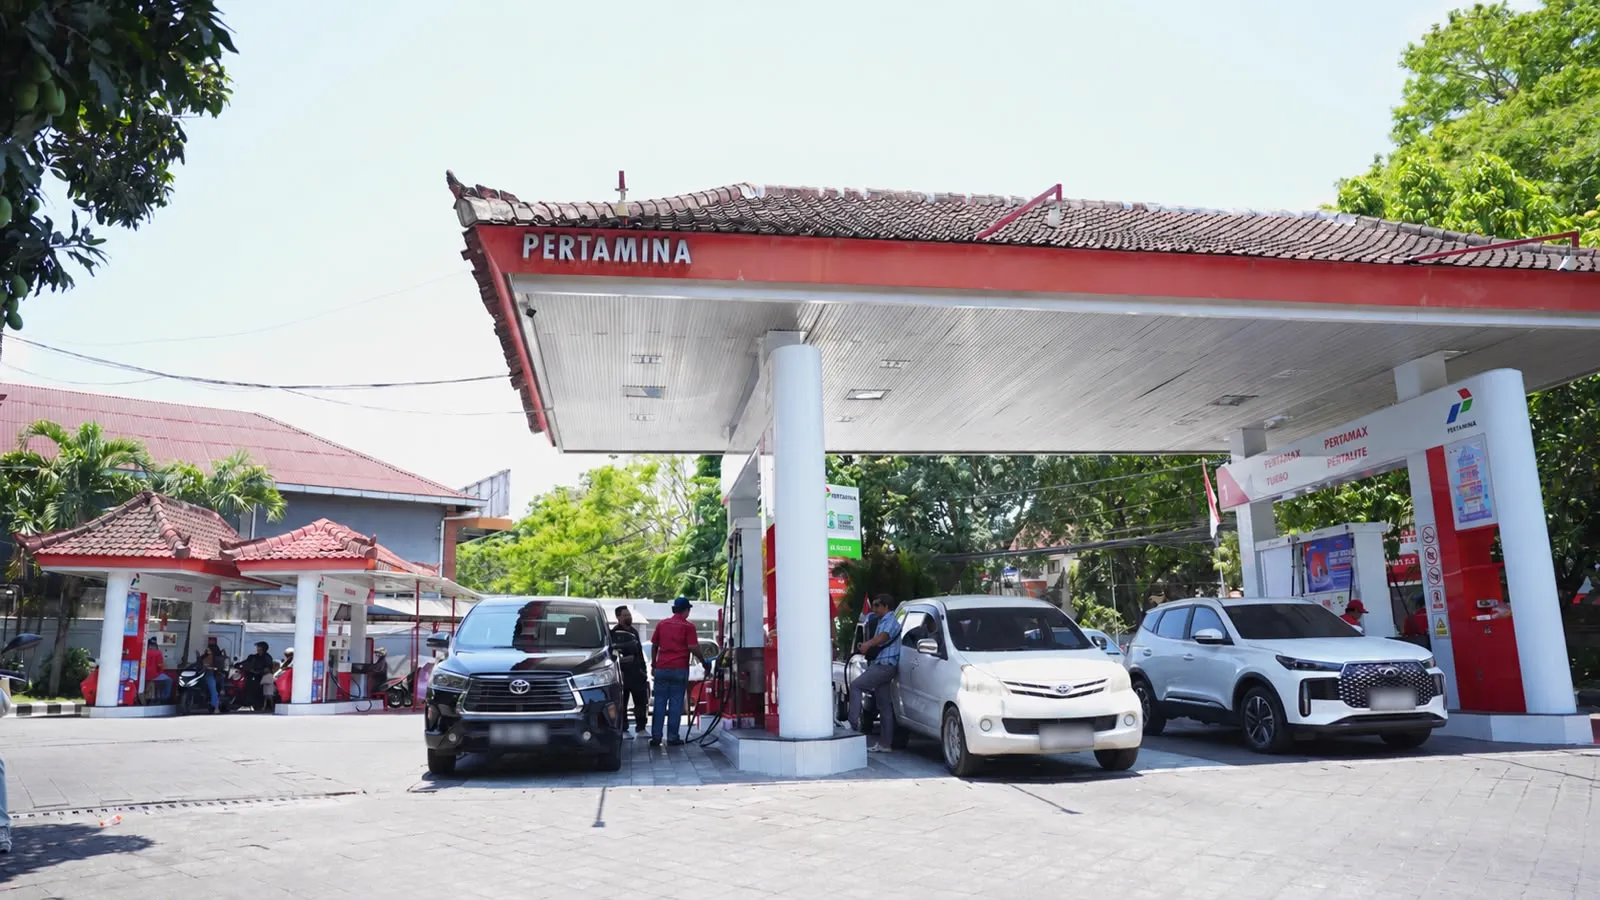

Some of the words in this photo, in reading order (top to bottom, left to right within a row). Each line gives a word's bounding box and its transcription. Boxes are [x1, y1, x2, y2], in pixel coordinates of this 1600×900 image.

[522, 232, 692, 264] PERTAMINA
[1324, 425, 1369, 450] PERTAMAX
[1447, 420, 1477, 434] PERTAMINA
[1264, 449, 1301, 470] PERTAMAX
[1326, 446, 1368, 469] PERTALITE
[1266, 472, 1289, 487] TURBO
